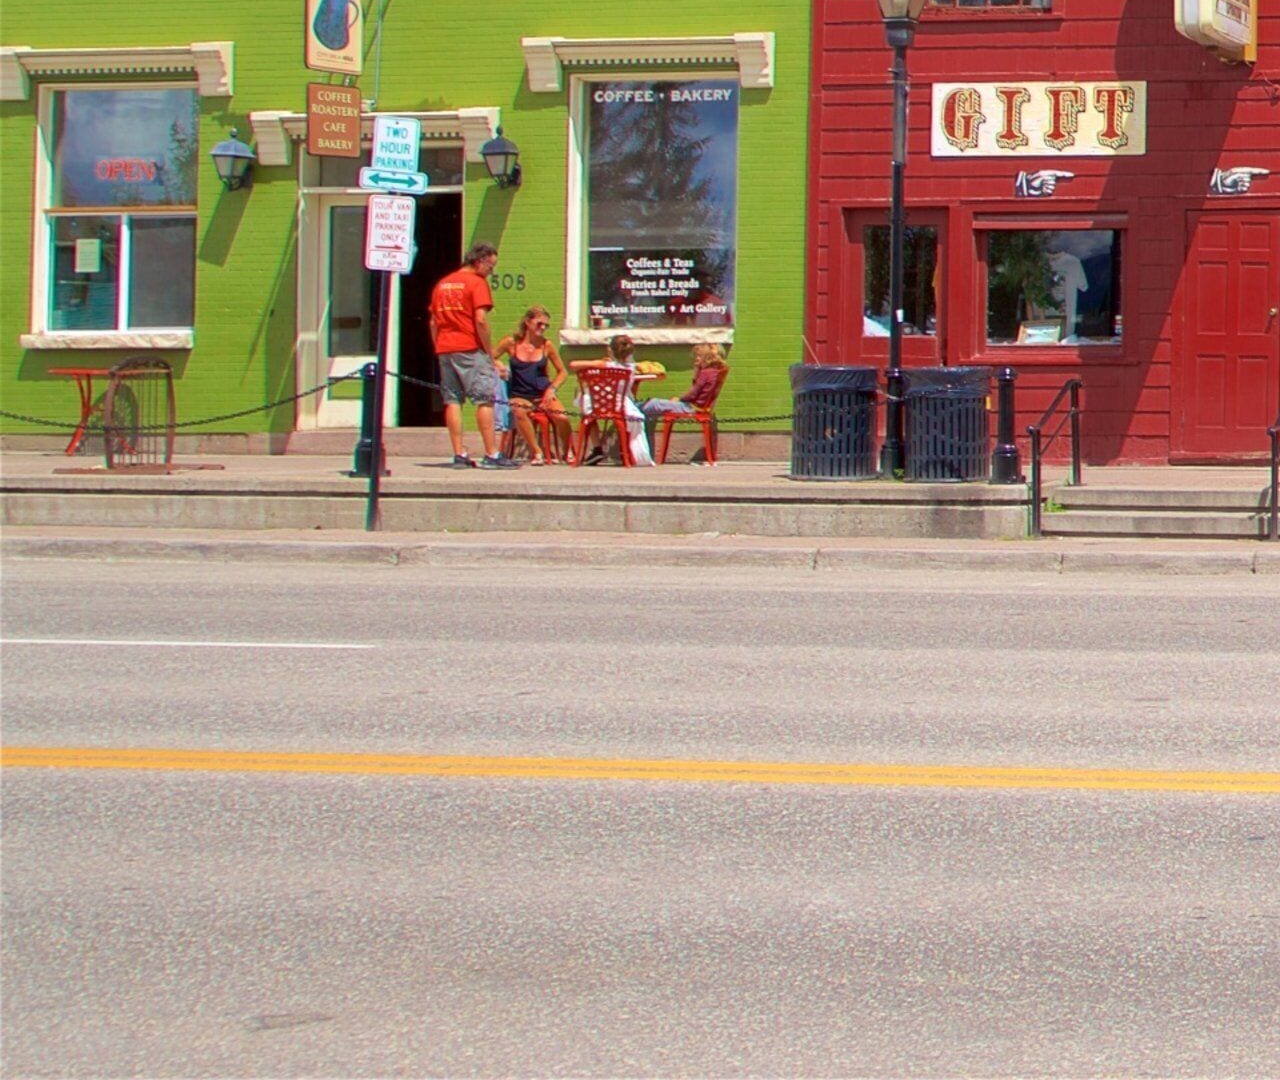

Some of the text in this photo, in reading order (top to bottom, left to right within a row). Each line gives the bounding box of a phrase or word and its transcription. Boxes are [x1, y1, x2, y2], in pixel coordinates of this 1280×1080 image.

[317, 90, 352, 104] COFFEE
[593, 89, 732, 102] COFFEE BAKERY
[311, 104, 358, 117] ROASTERY
[941, 85, 1135, 152] GIFT
[323, 121, 347, 133] CAFE
[386, 126, 409, 139] TWO
[317, 137, 353, 150] BAKERY
[380, 142, 411, 155] HOUR
[375, 156, 415, 170] PARKING
[96, 159, 156, 181] OPEN
[397, 202, 412, 211] VAN
[393, 213, 409, 221] TAXI
[375, 222, 407, 232] PARKING
[381, 233, 399, 242] ONLY
[626, 258, 661, 268] Coffees
[674, 258, 694, 268] Teas
[620, 280, 657, 289] Pastries
[668, 279, 699, 289] Breads
[592, 304, 728, 314] Wireless Internet Art Gallery
